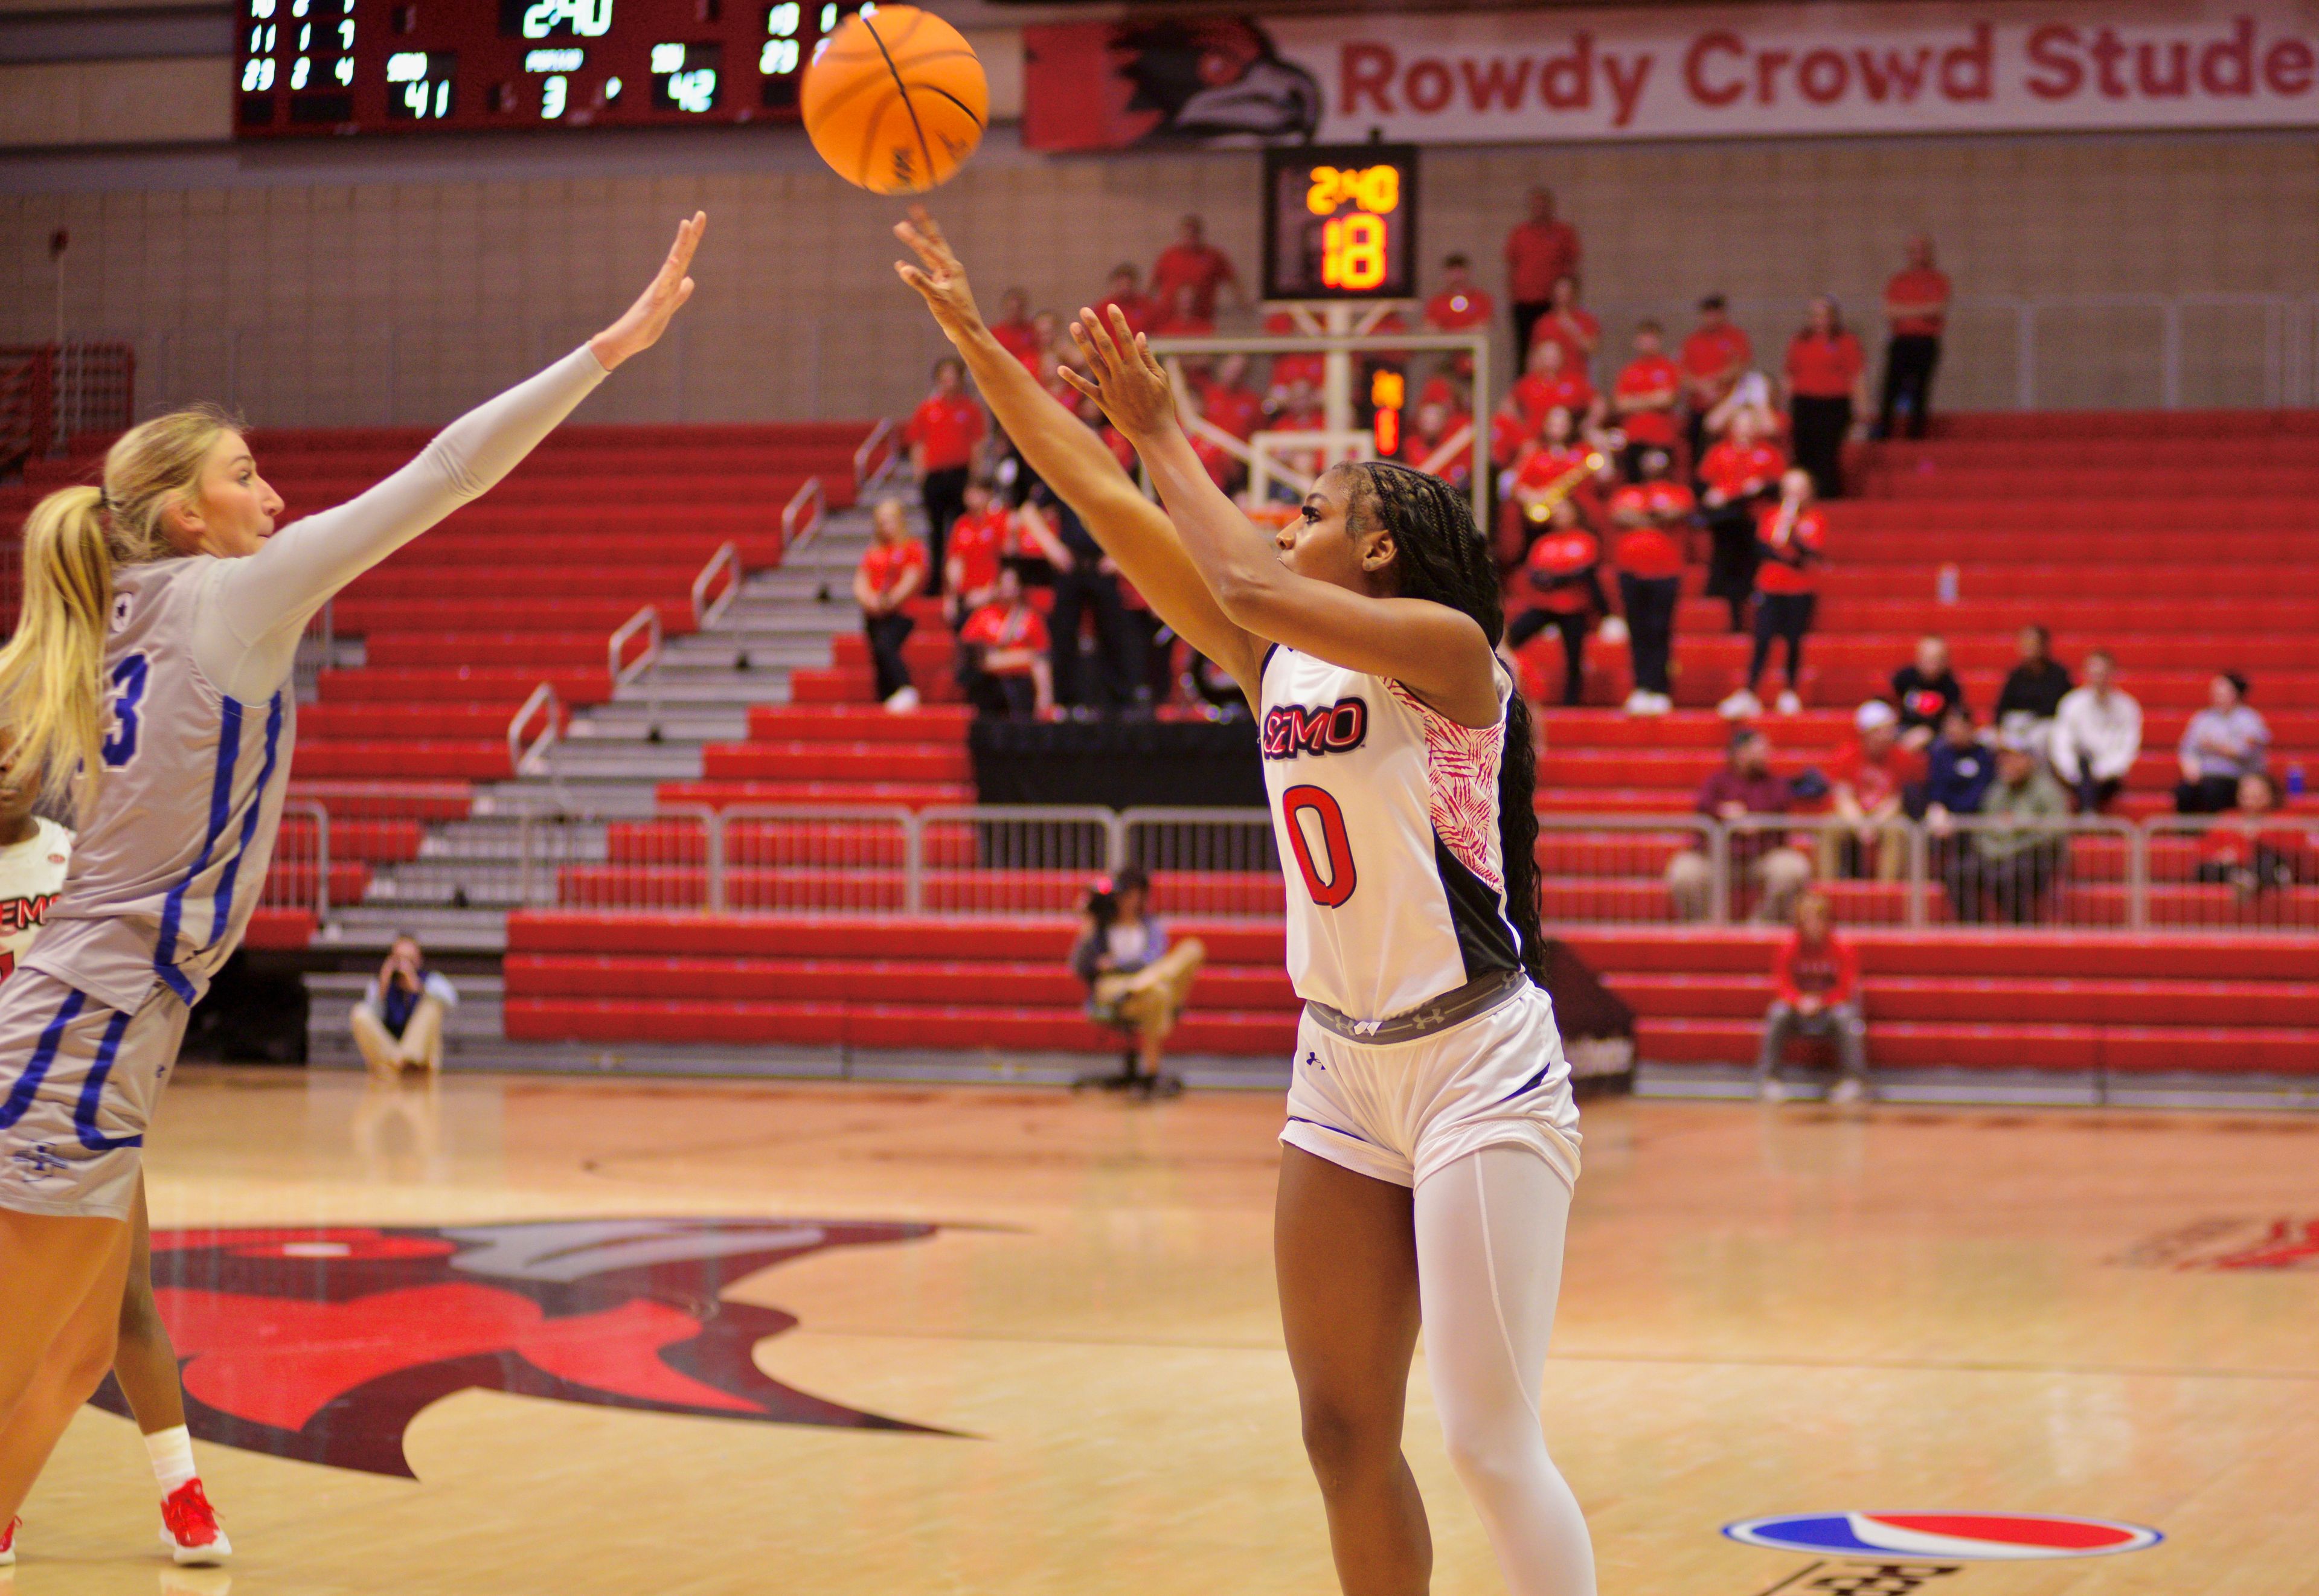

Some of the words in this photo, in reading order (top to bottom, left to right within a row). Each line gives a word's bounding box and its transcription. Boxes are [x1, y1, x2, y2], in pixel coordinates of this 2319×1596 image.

[251, 24, 276, 53] 11
[300, 22, 311, 52] 1
[541, 75, 568, 119] 3
[668, 69, 716, 112] 42
[1339, 33, 1655, 126] Rowdy
[1688, 22, 1993, 106] Crowd
[2026, 17, 2315, 100] Stude
[405, 79, 449, 119] 41
[1322, 213, 1387, 290] 18
[1263, 697, 1367, 761] SEMO
[1283, 784, 1357, 909] 0
